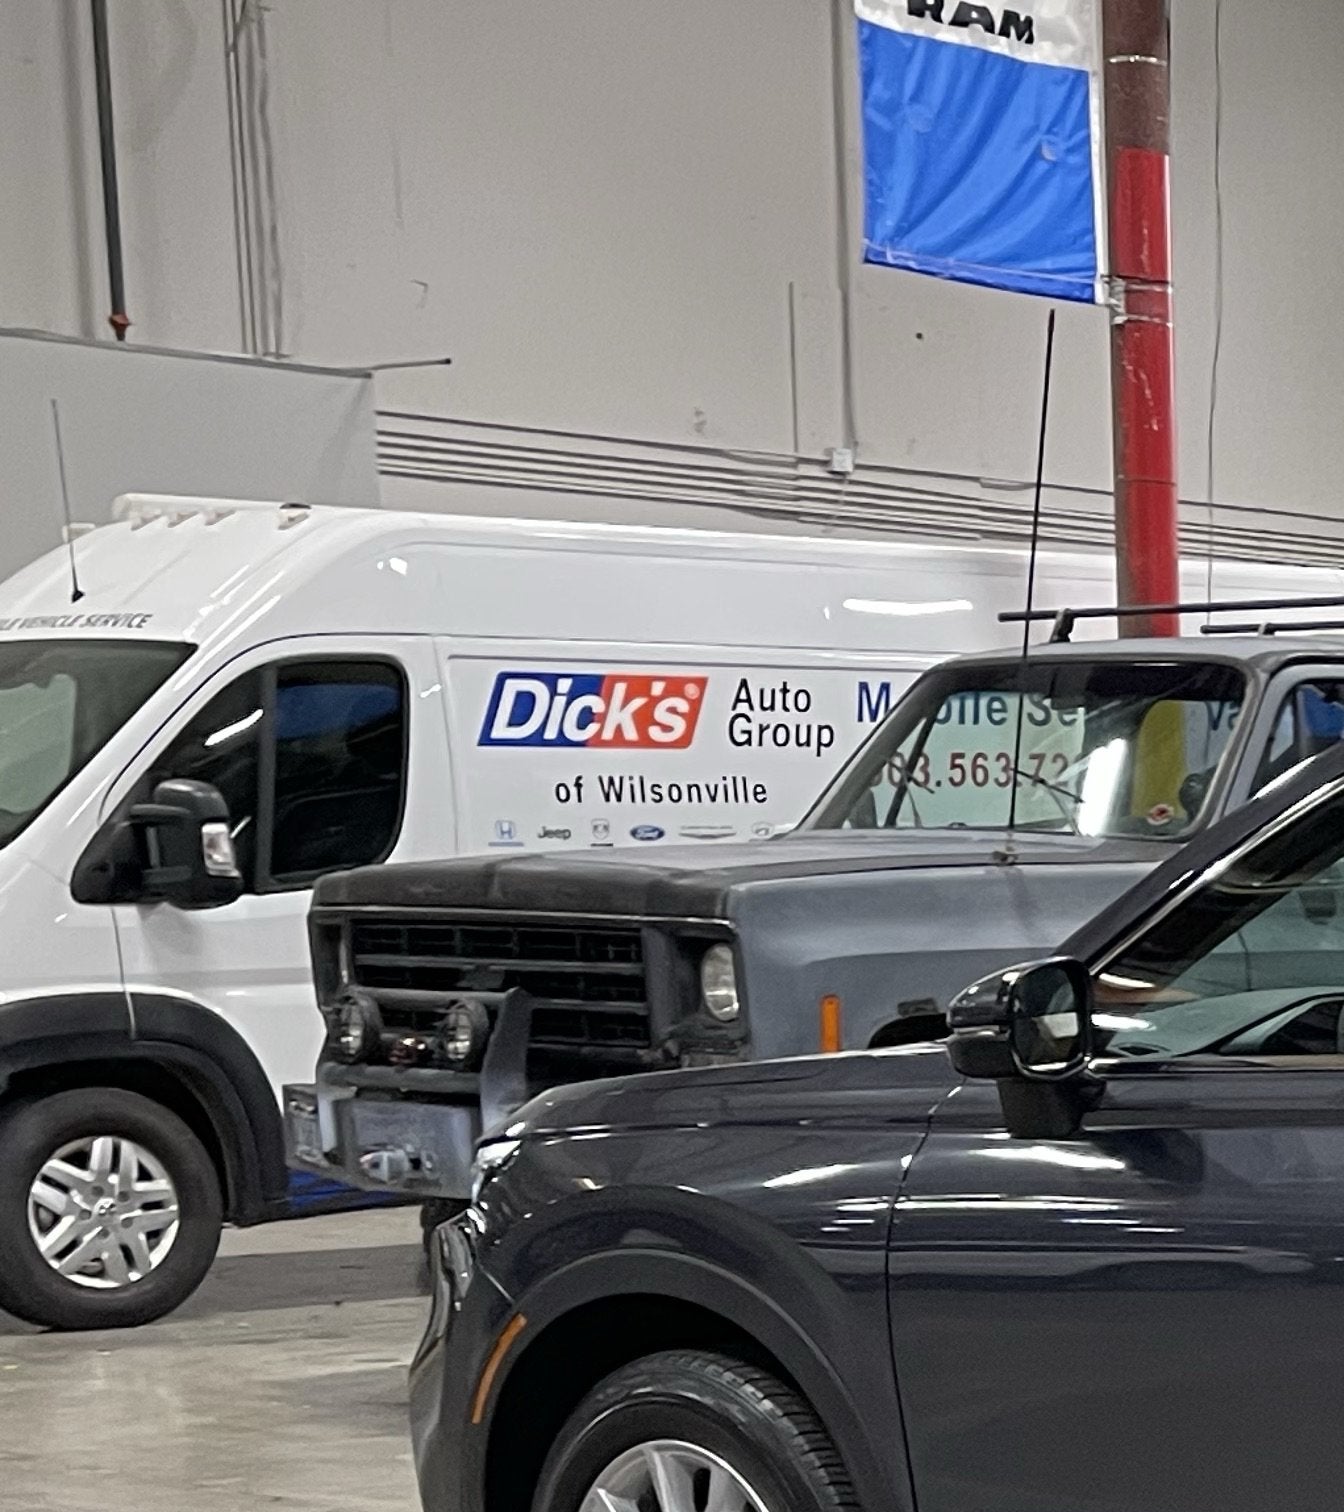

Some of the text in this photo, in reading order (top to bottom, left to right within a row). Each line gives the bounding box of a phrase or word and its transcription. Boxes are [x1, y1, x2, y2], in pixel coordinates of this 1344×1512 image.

[907, 0, 1034, 44] RAM
[489, 678, 691, 742] Dick's
[731, 678, 812, 713] Auto
[728, 713, 835, 757] Group
[555, 775, 768, 804] of Wilsonville
[537, 826, 572, 840] Jeep
